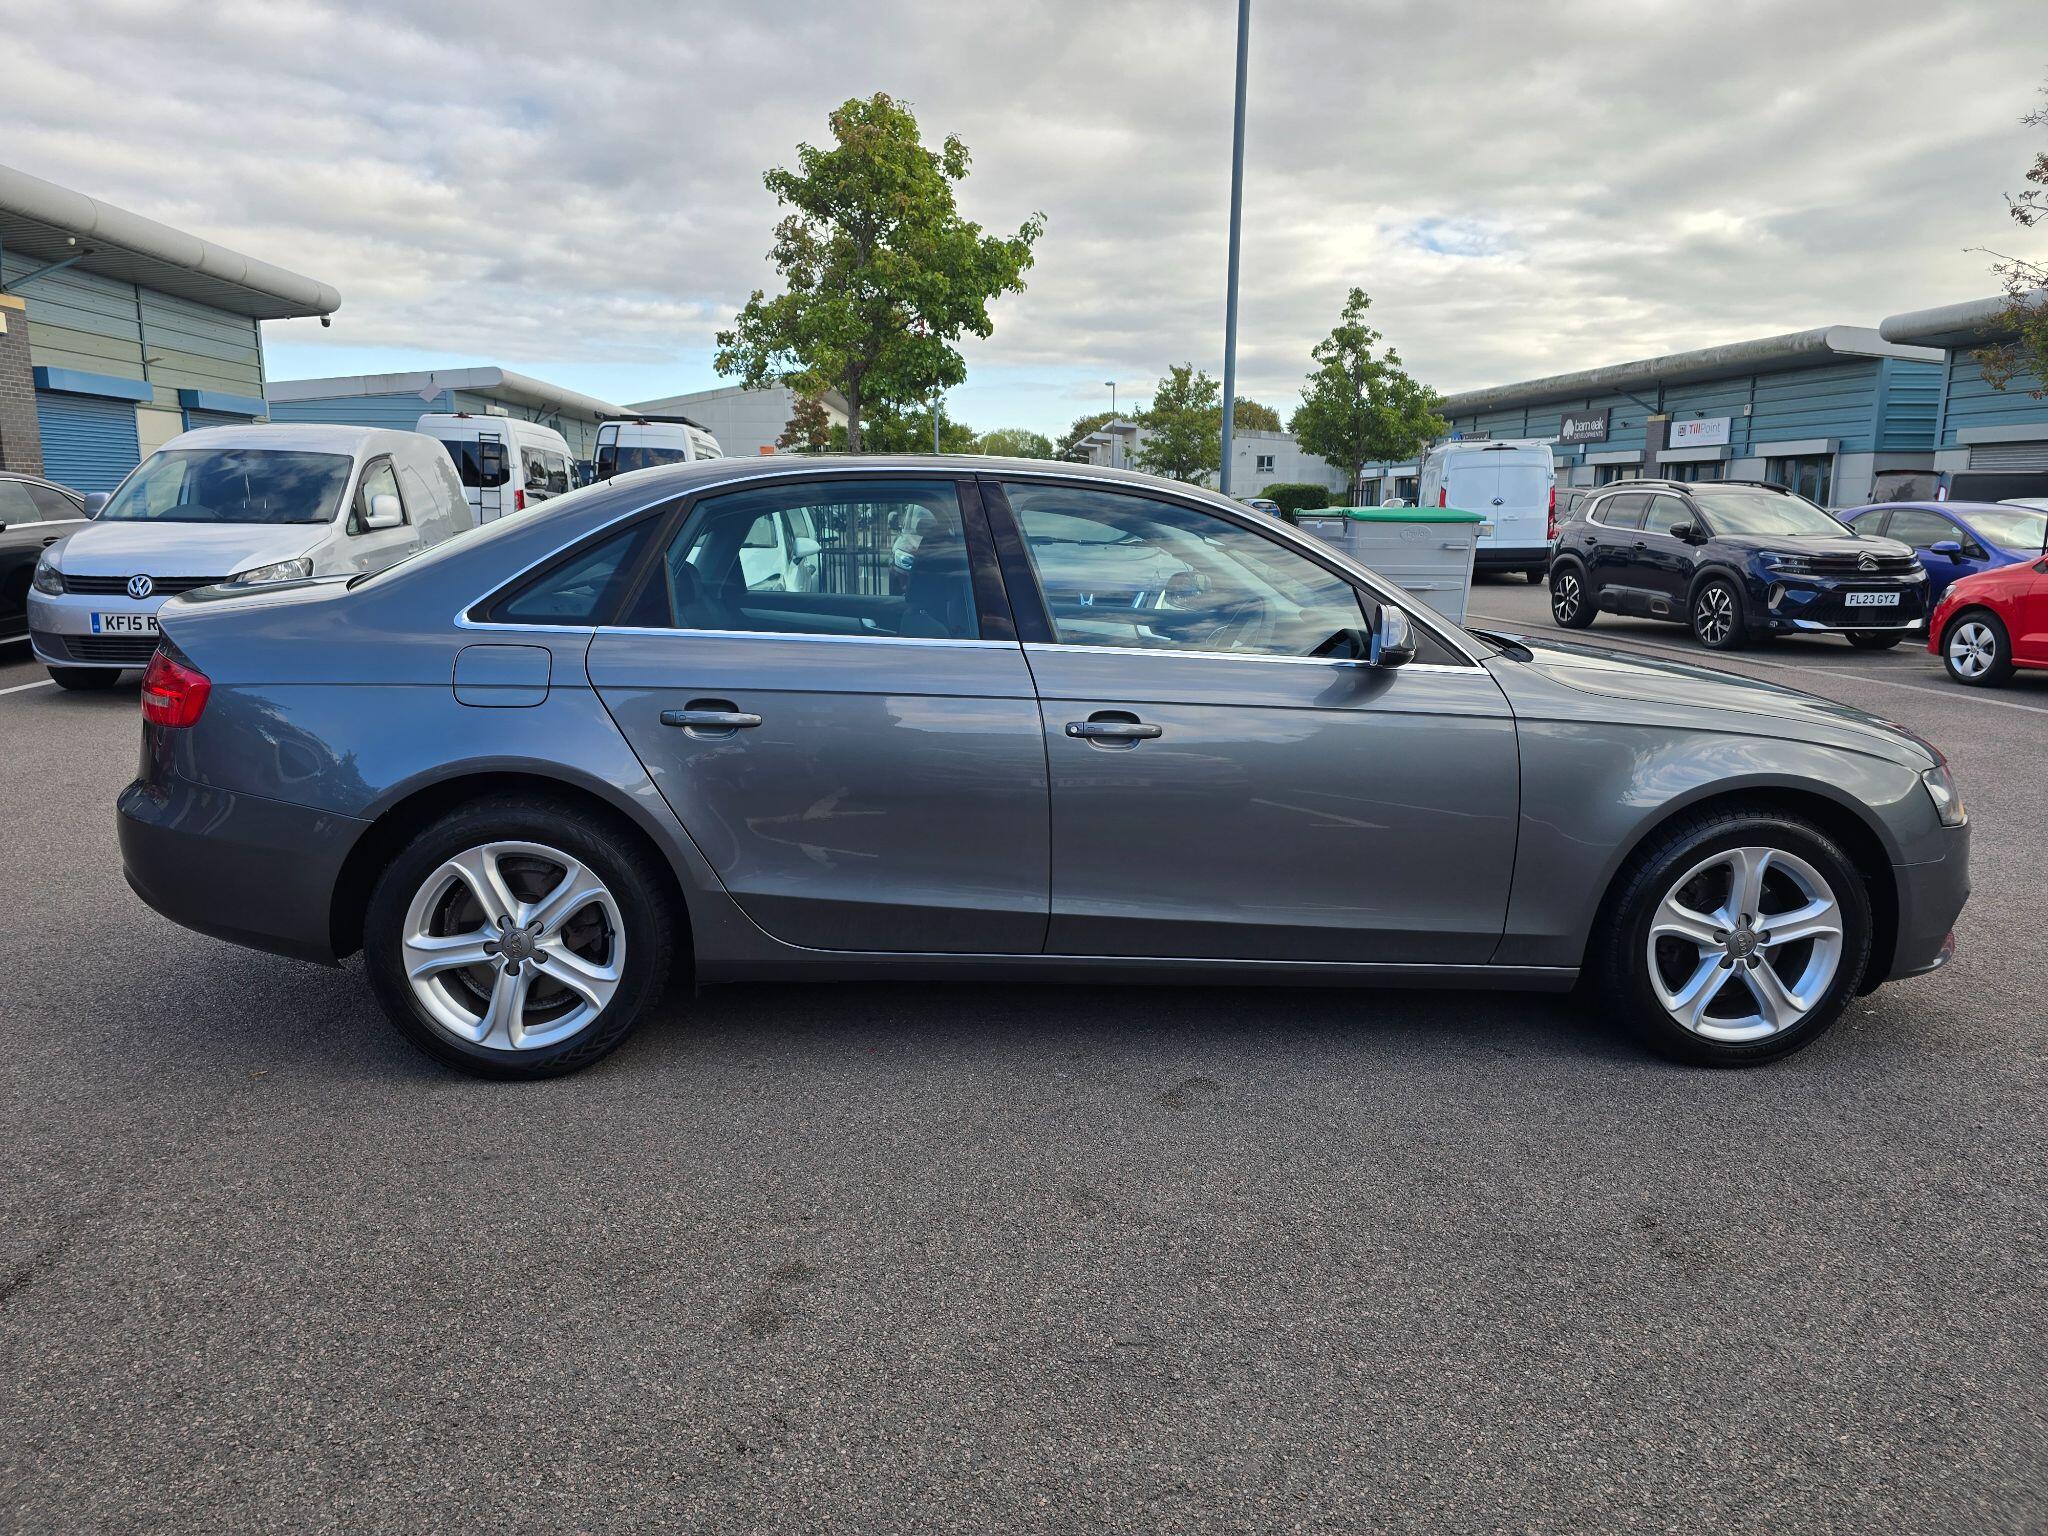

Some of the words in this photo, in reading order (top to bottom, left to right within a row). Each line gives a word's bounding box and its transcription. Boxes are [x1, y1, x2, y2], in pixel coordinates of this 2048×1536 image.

[1574, 419, 1591, 432] barn
[1590, 416, 1604, 431] oak
[1688, 422, 1721, 435] TillPoint
[1849, 594, 1876, 605] FL23
[1877, 594, 1896, 604] GYZ
[105, 615, 143, 631] KF15
